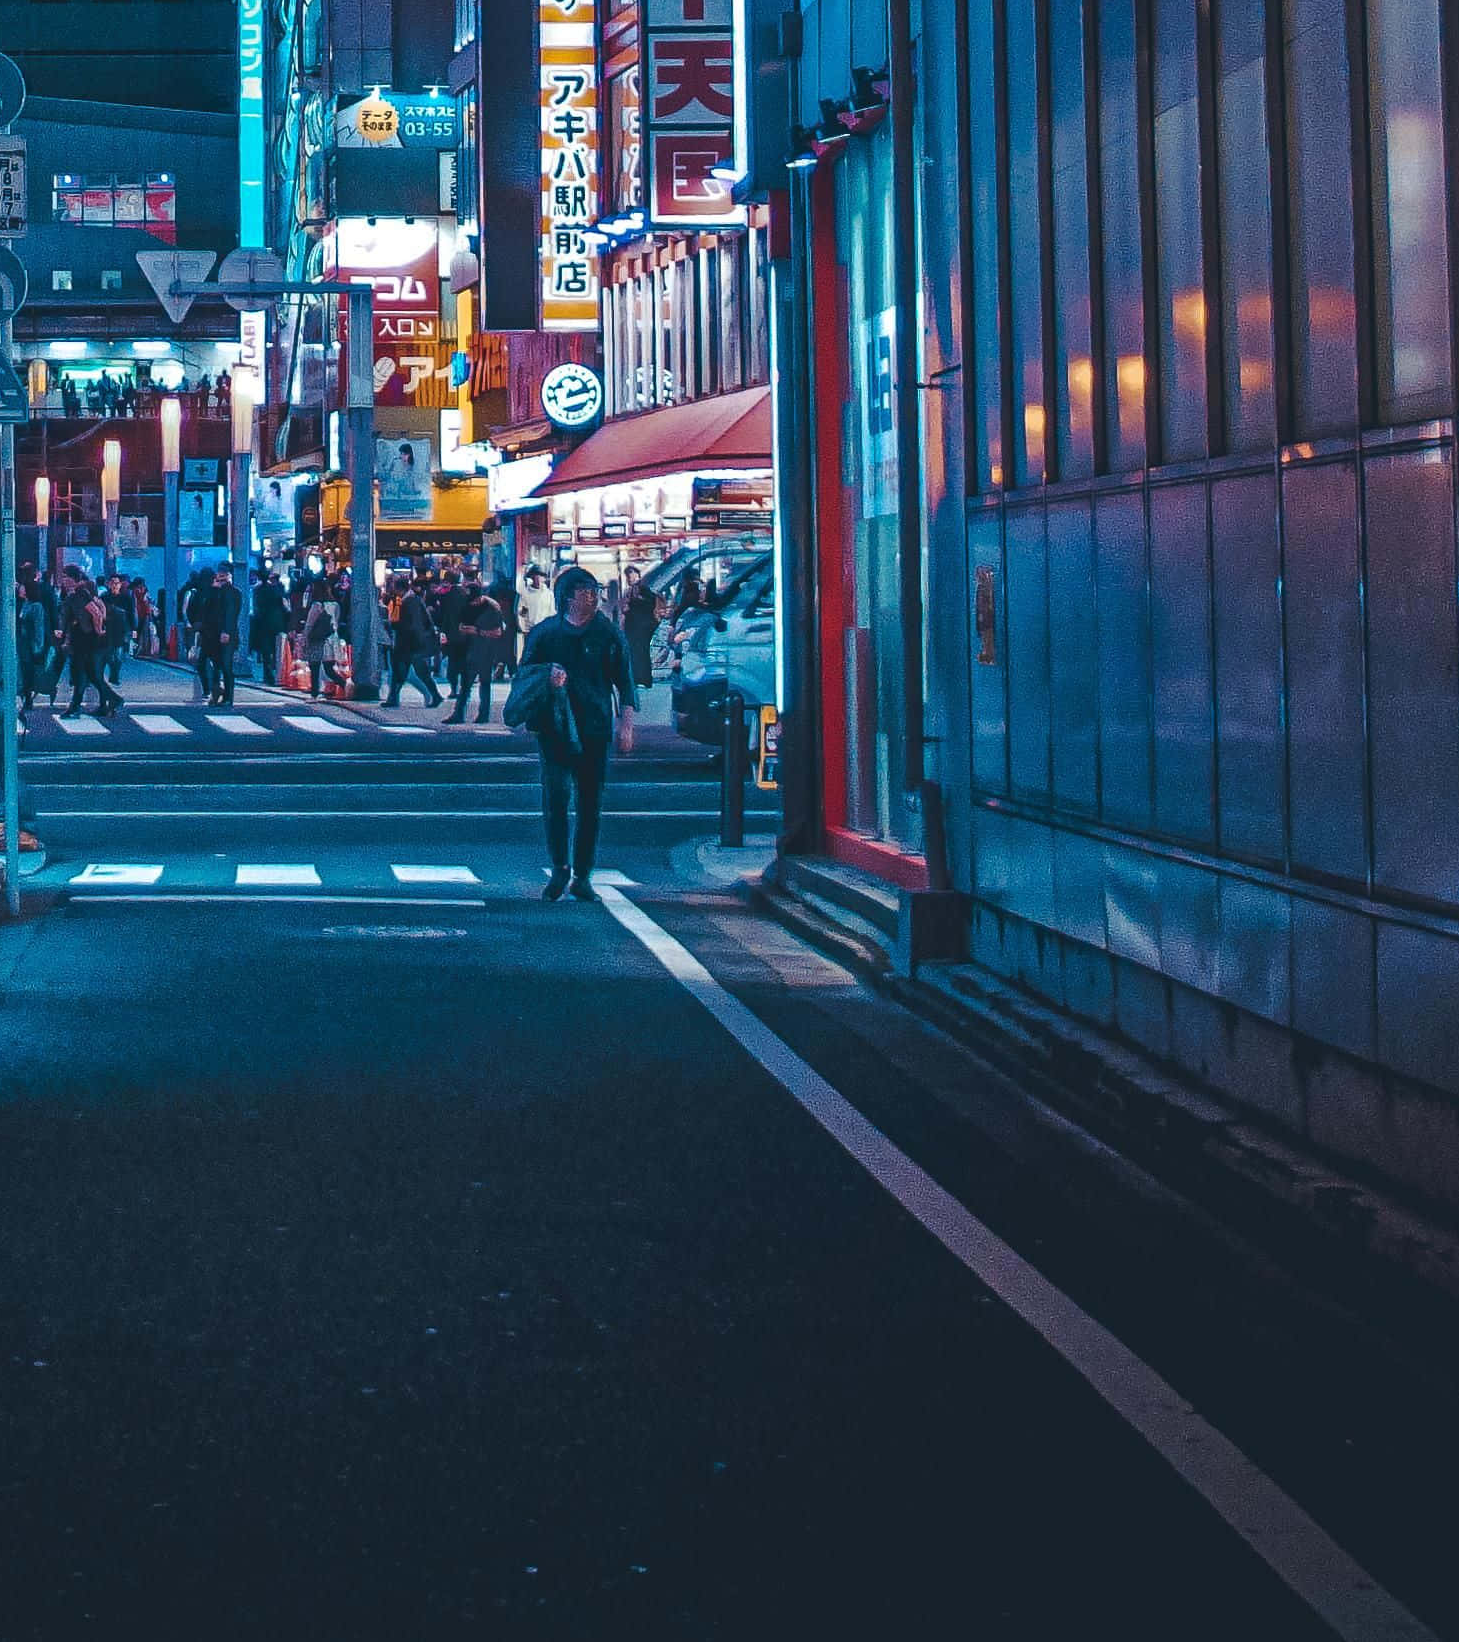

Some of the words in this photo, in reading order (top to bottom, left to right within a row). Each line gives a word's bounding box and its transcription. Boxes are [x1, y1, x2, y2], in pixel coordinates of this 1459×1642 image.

[361, 110, 393, 121] データ
[361, 121, 393, 132] そのまま
[404, 122, 453, 137] 03-55
[552, 74, 587, 294] アキバ駅前店
[377, 318, 415, 337] 入口
